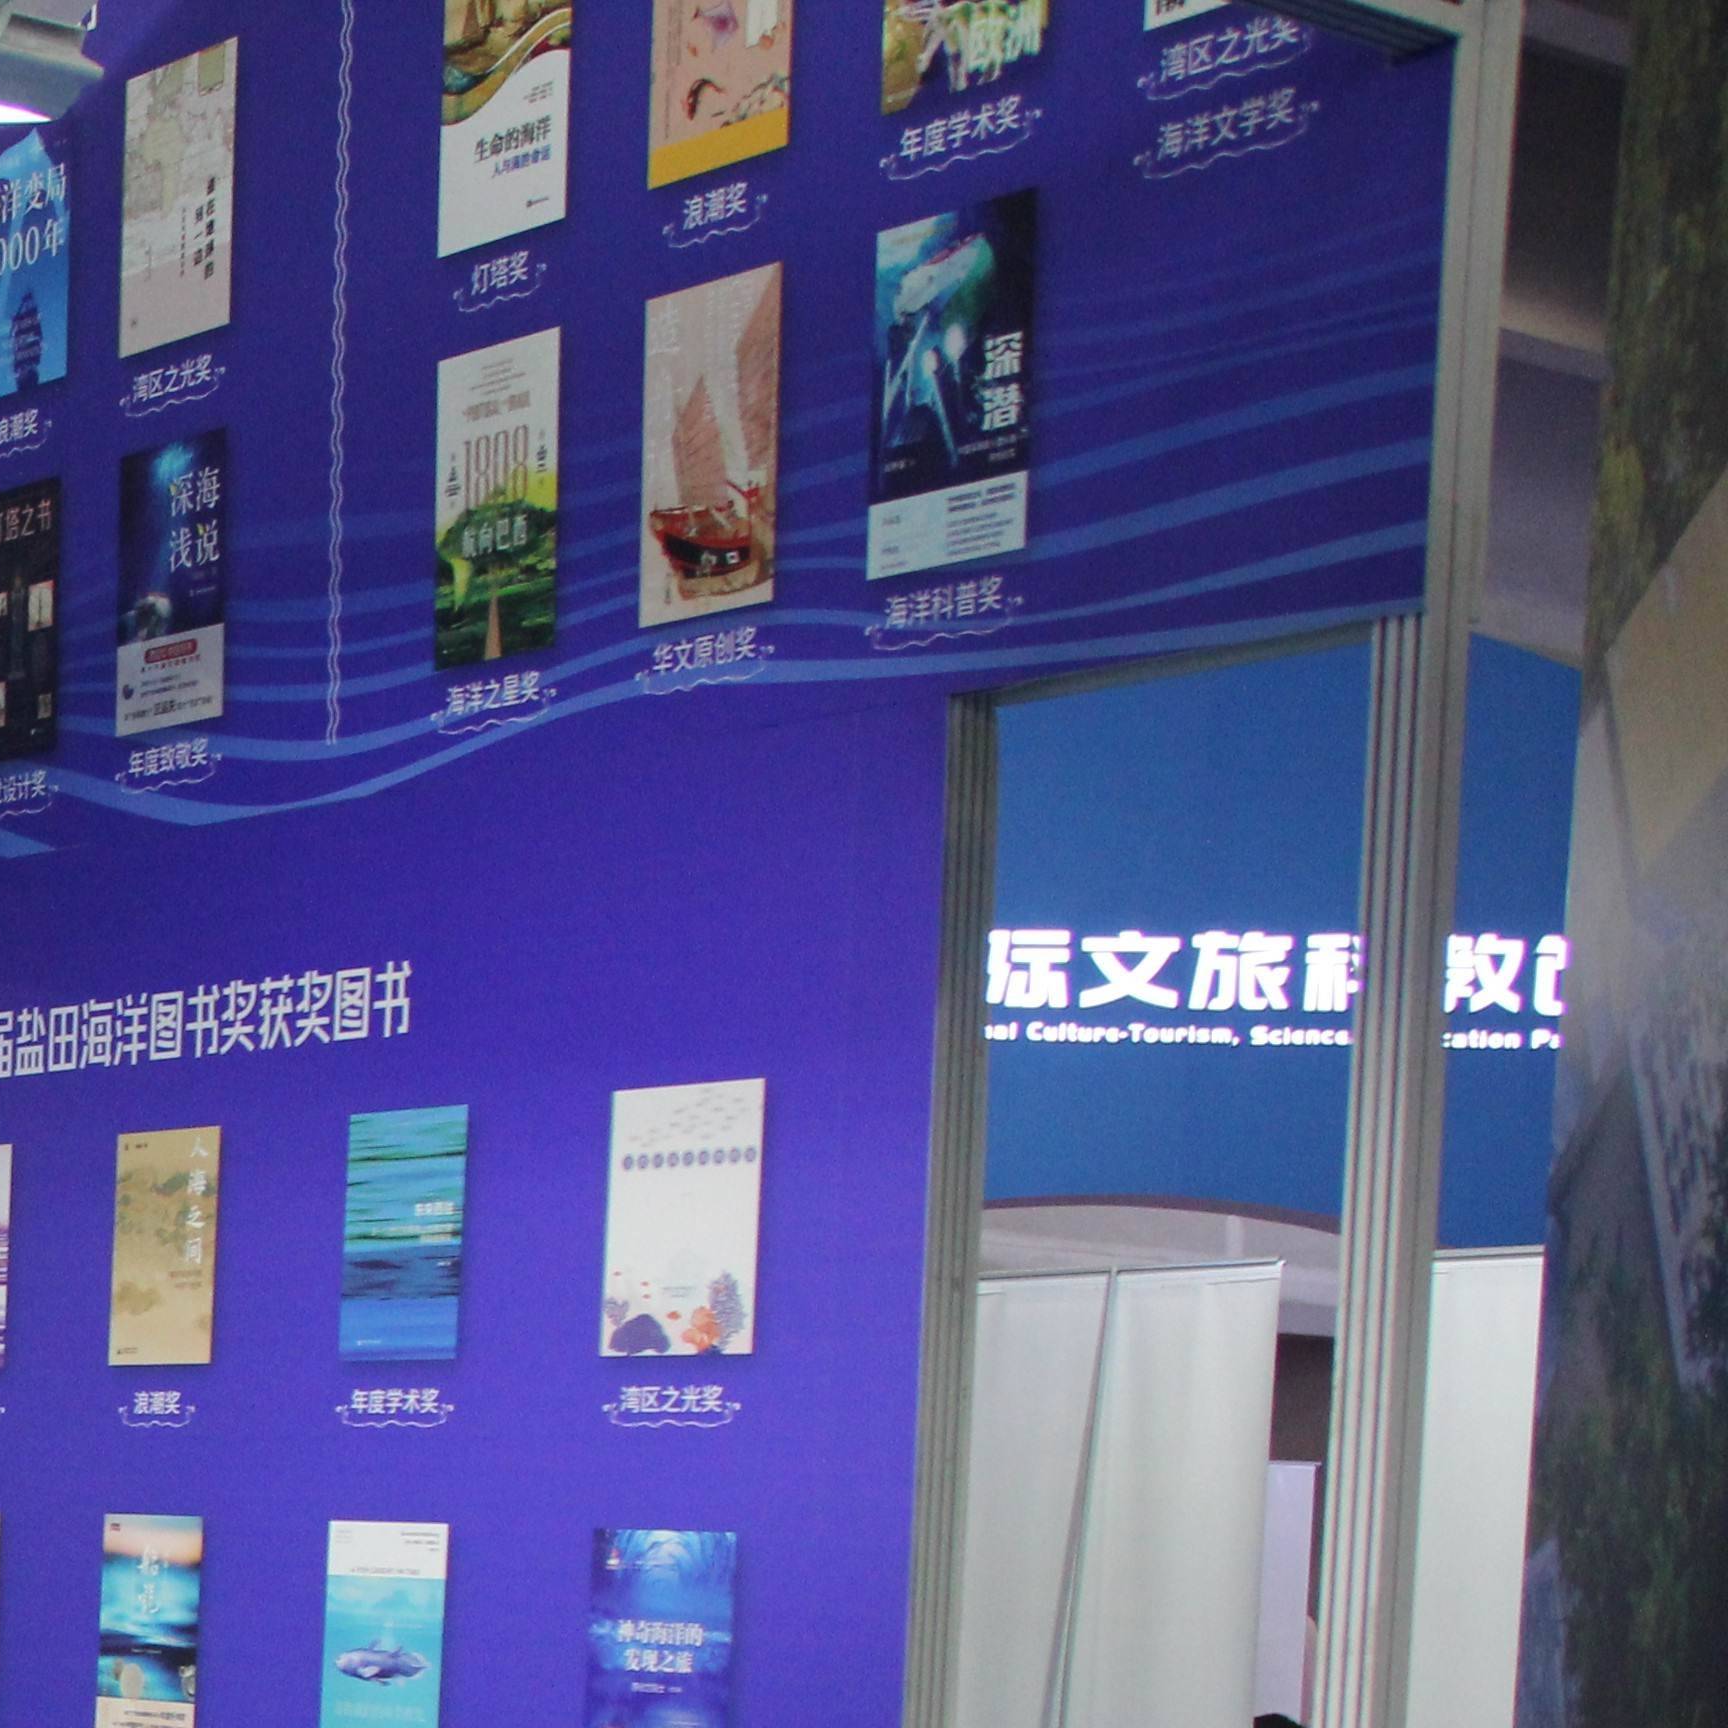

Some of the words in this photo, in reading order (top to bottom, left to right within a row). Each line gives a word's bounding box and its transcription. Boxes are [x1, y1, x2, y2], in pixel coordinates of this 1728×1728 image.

[1159, 17, 1299, 83] 湾区之光奖
[900, 96, 1021, 161] 年度学术奖
[1158, 88, 1296, 160] 海洋文学奖
[682, 182, 749, 231] 浪潮奖
[471, 250, 530, 297] 灯塔奖
[132, 354, 213, 403] 湾区之光奖
[171, 466, 221, 518] 深海
[170, 521, 221, 574] 浅说
[885, 575, 1005, 631] 海洋科普奖
[653, 627, 757, 672] 华文原创奖
[446, 672, 541, 716] 海洋之星奖
[129, 738, 209, 779] 年度致敬奖
[1026, 1021, 1240, 1049] Culture-Tourism,
[133, 1391, 182, 1416] 浪潮奖
[351, 1388, 440, 1415] 年度学术奖
[620, 1385, 723, 1414] 湾区之光奖
